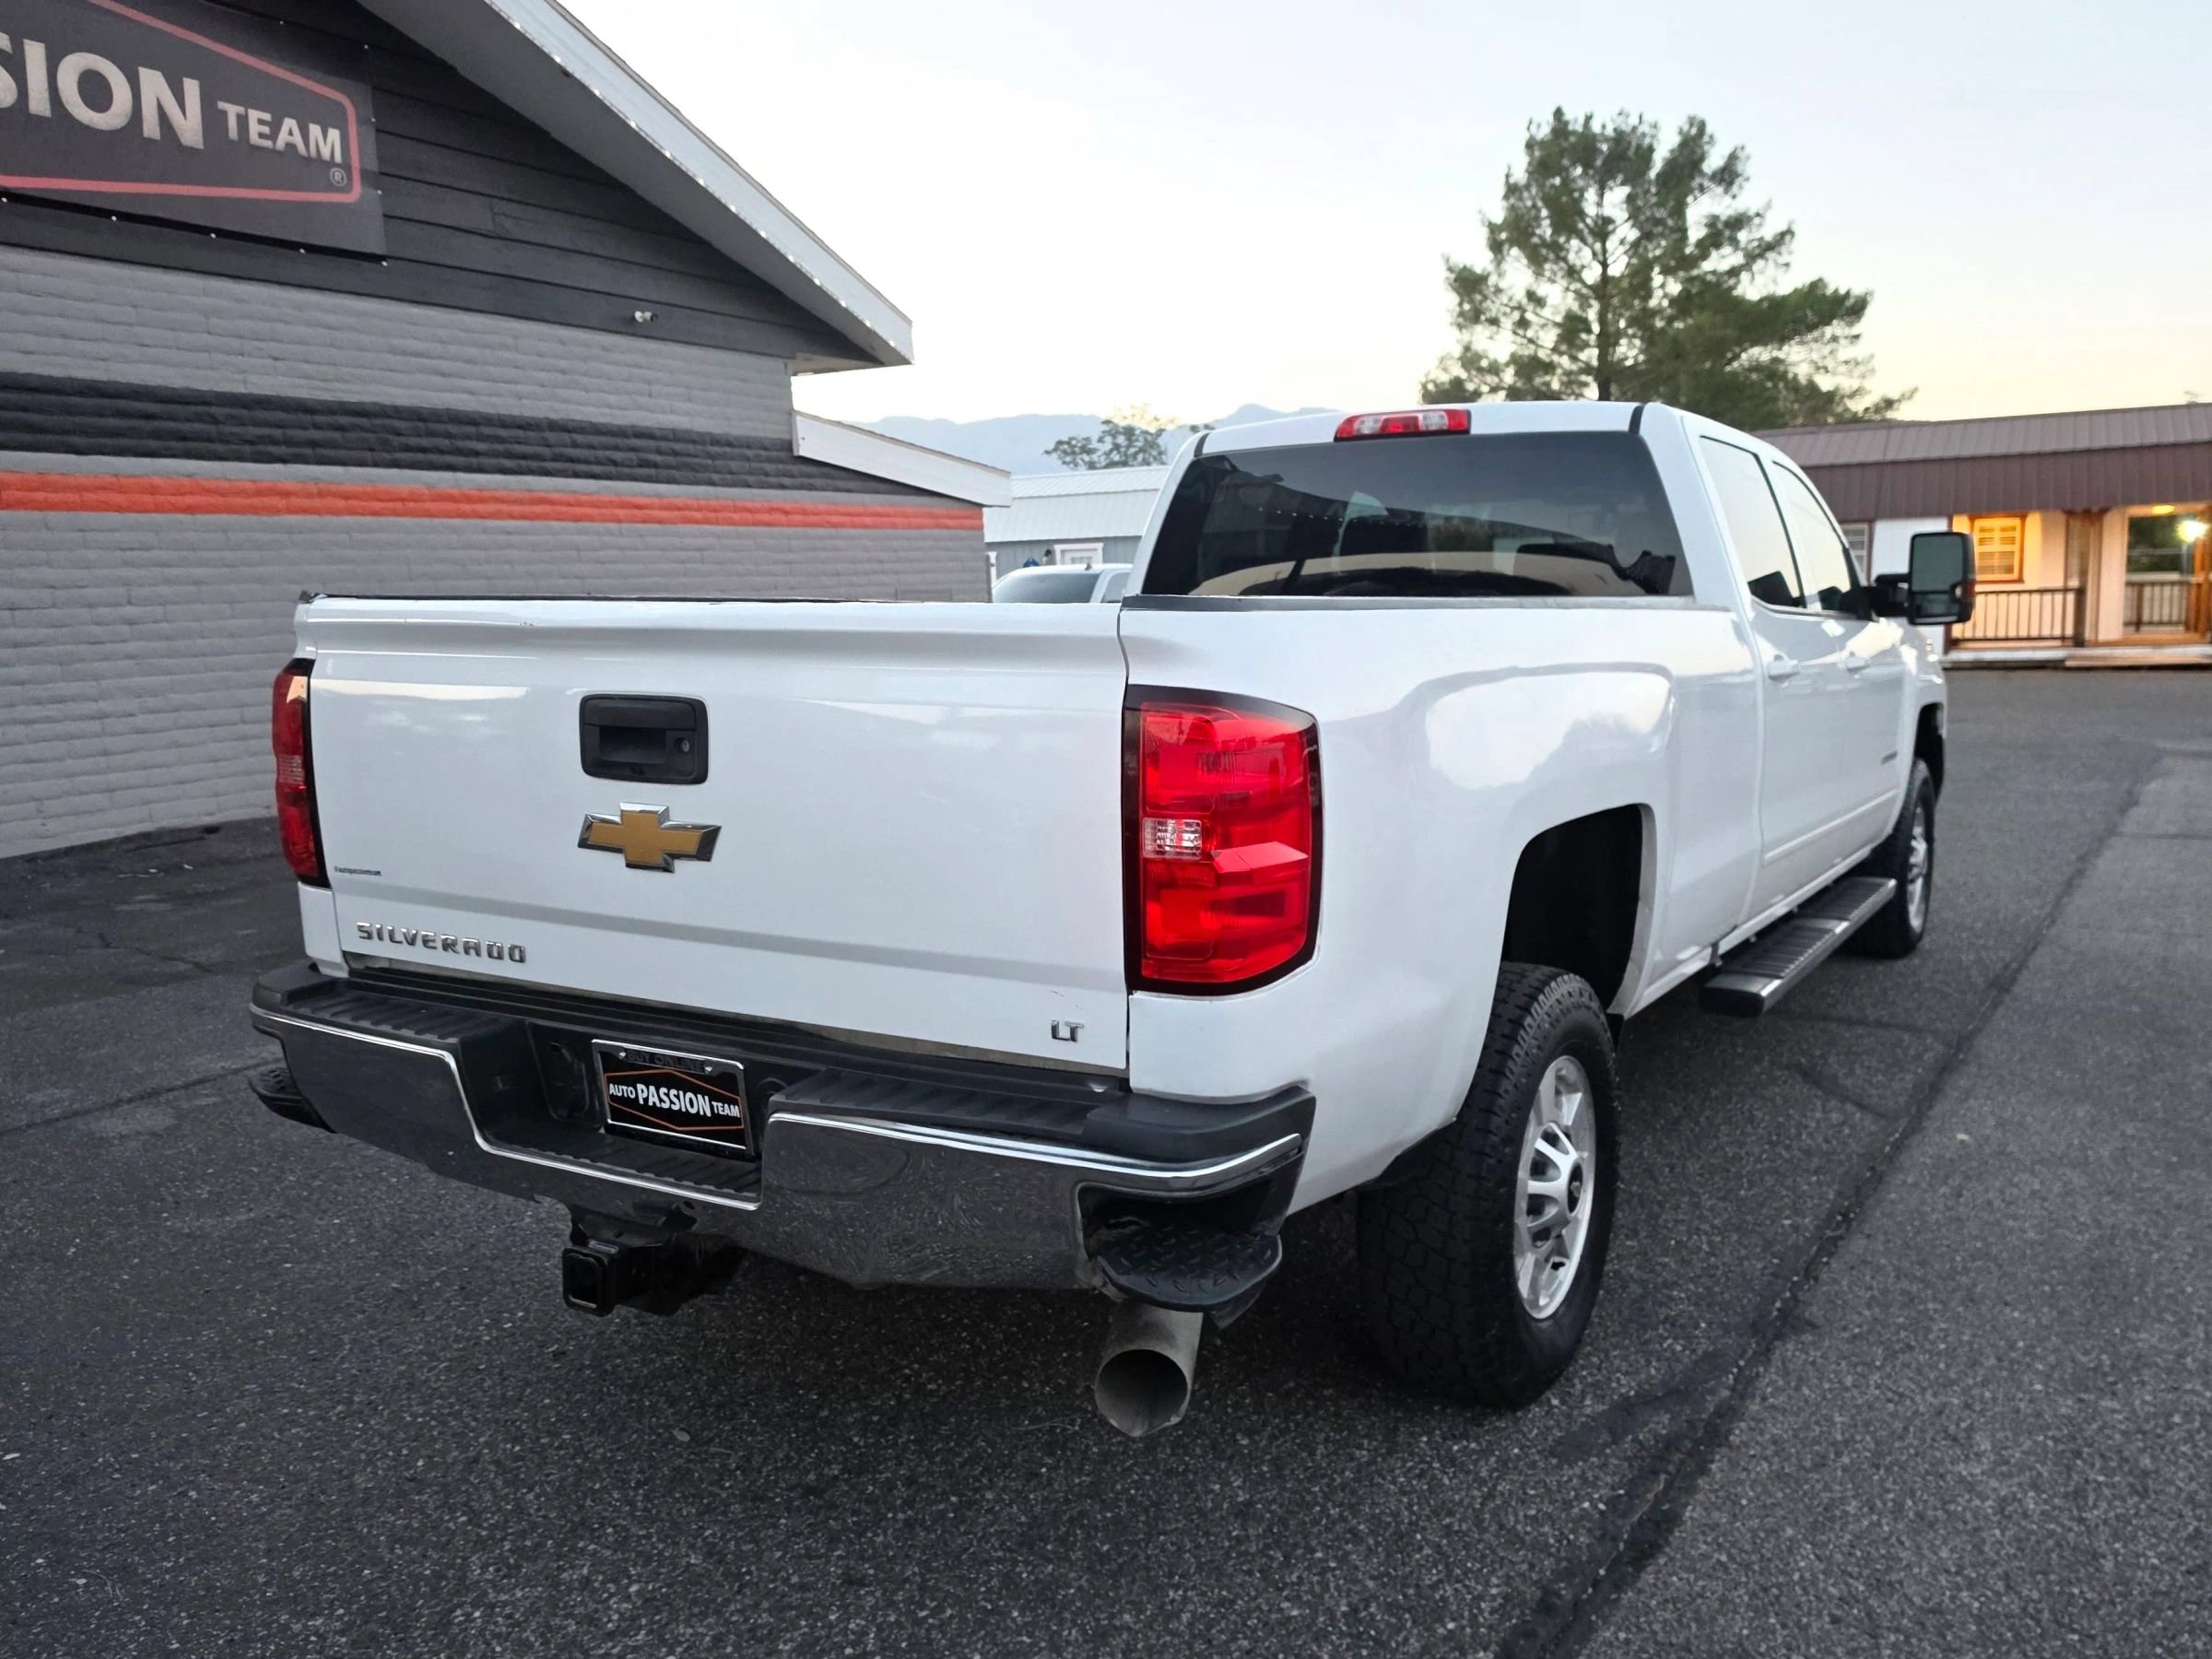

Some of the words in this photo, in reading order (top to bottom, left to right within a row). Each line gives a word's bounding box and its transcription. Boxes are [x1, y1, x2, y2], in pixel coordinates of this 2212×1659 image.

[218, 100, 343, 164] TEAM
[356, 922, 527, 964] SILVERADO
[1051, 1019, 1085, 1042] LT
[609, 1083, 636, 1100] AUTO
[636, 1083, 712, 1118] PASSION
[712, 1100, 741, 1119] TEAM
